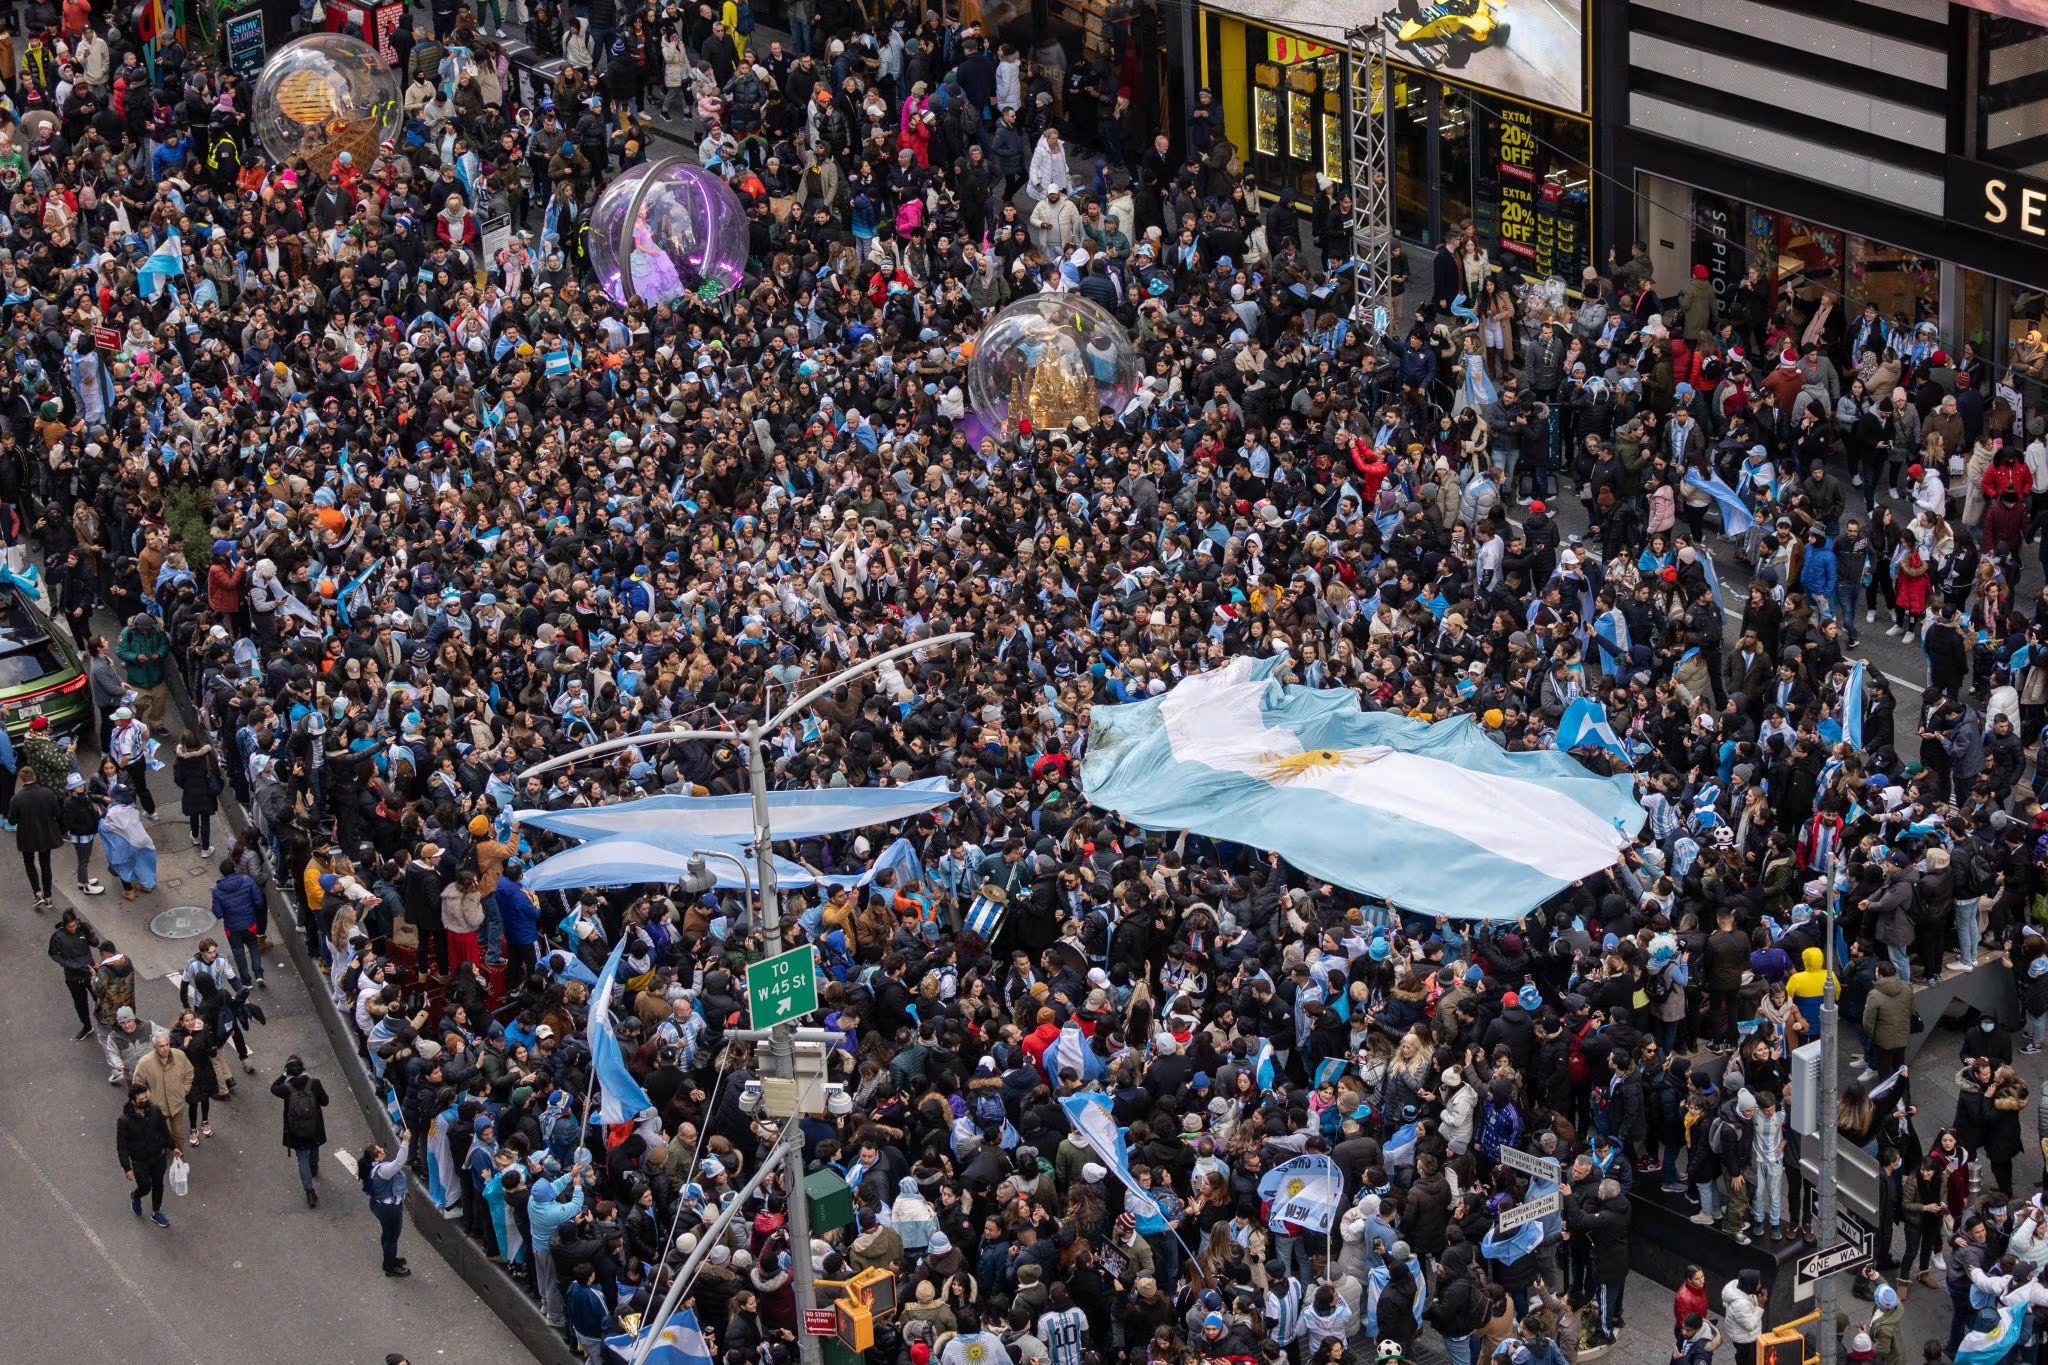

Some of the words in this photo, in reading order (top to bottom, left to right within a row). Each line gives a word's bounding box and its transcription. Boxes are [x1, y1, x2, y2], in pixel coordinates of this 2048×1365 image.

[1502, 109, 1532, 125] EXTRA
[1501, 125, 1535, 149] 20%
[1502, 187, 1532, 202] EXTRA
[1501, 200, 1535, 226] 20%
[1984, 179, 2047, 236] SE
[772, 961, 789, 977] TO
[758, 986, 769, 1001] W
[771, 979, 790, 995] 45
[793, 973, 806, 988] St
[1503, 1148, 1530, 1163] PEDESTRIAN
[1542, 1162, 1554, 1171] ZONE
[1503, 1156, 1515, 1164] KEEP
[1515, 1160, 1532, 1171] MOVING
[1502, 1207, 1529, 1220] PEDESTRIAN
[1529, 1201, 1542, 1210] FLOW
[1542, 1196, 1554, 1206] ZONE
[1525, 1210, 1537, 1219] KEEP
[1537, 1204, 1555, 1215] MOVING
[1841, 1222, 1858, 1240] WAY
[1809, 1257, 1830, 1273] ONE
[1840, 1248, 1861, 1261] WA
[1054, 1324, 1077, 1348] 10
